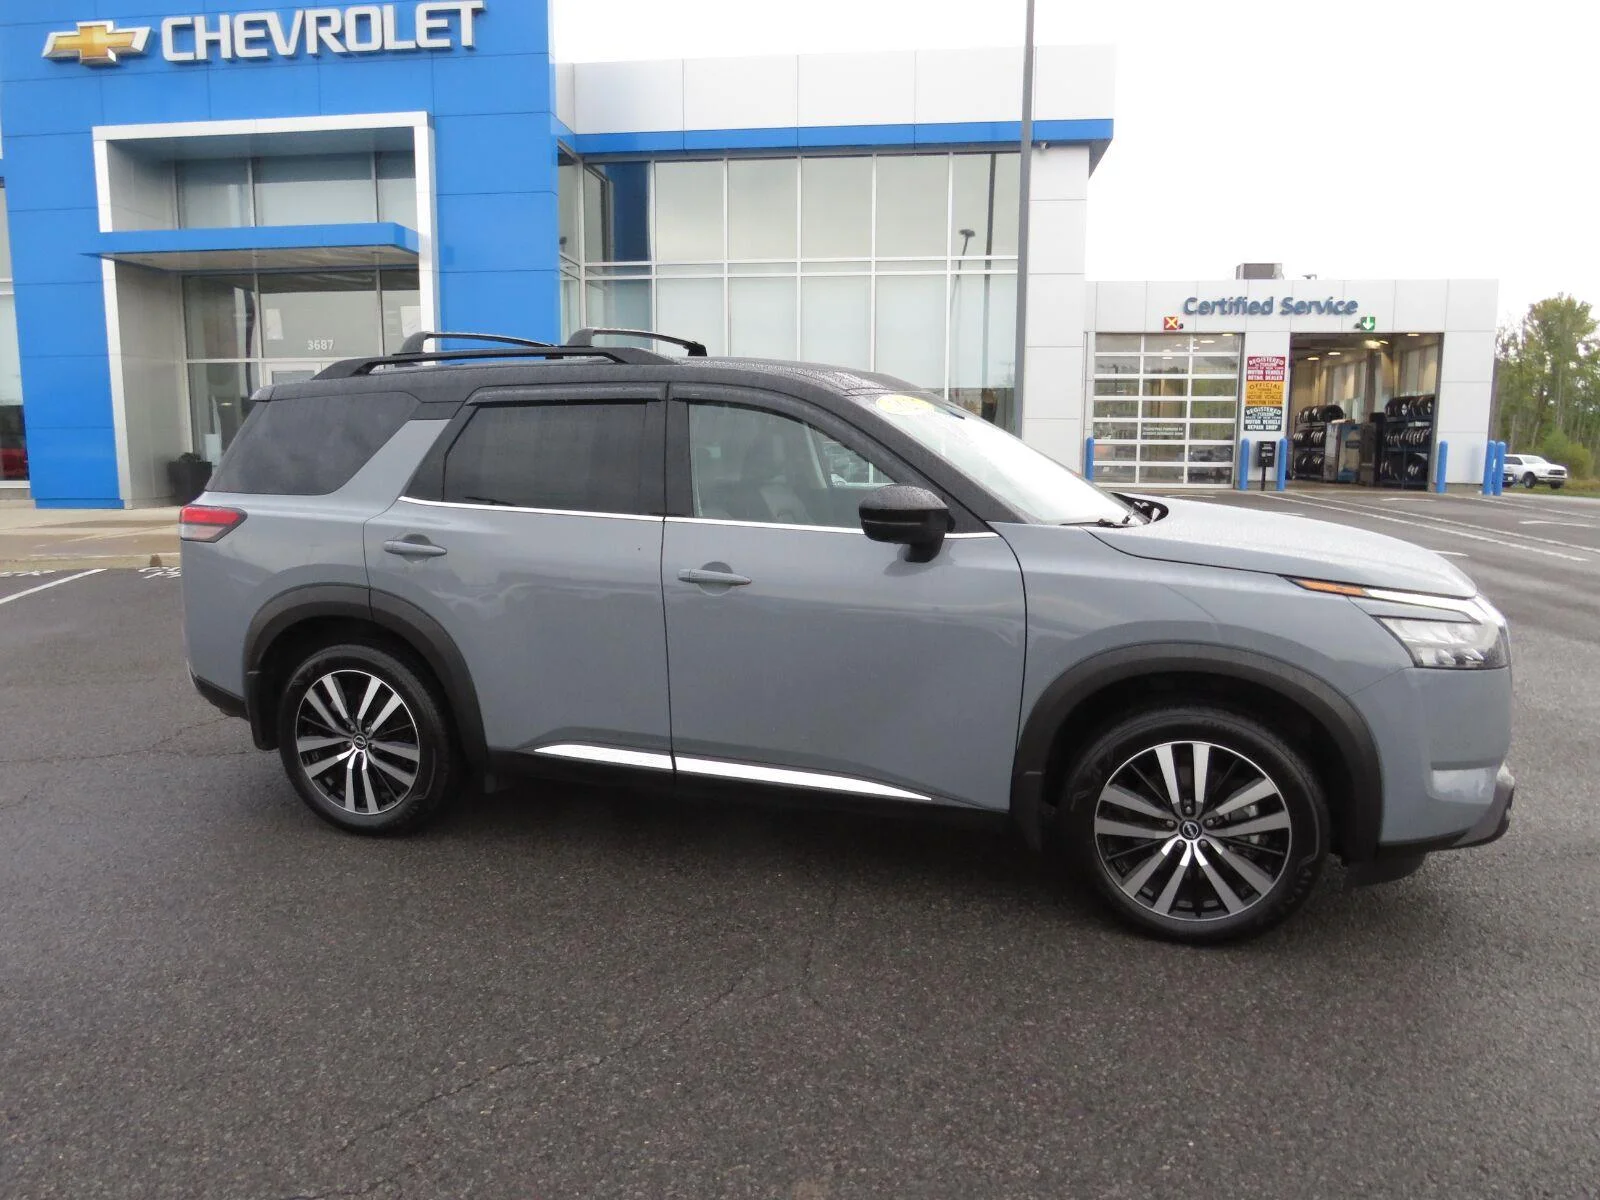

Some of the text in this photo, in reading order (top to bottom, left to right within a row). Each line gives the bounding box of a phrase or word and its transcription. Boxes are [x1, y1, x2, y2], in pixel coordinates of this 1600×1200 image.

[161, 0, 485, 62] CHEVROLET
[1183, 296, 1359, 316] Certified Service
[307, 339, 334, 350] 3687
[1248, 356, 1285, 366] REGISTERED
[1249, 382, 1280, 390] OFFICIAL
[1246, 406, 1282, 415] REGISTERED
